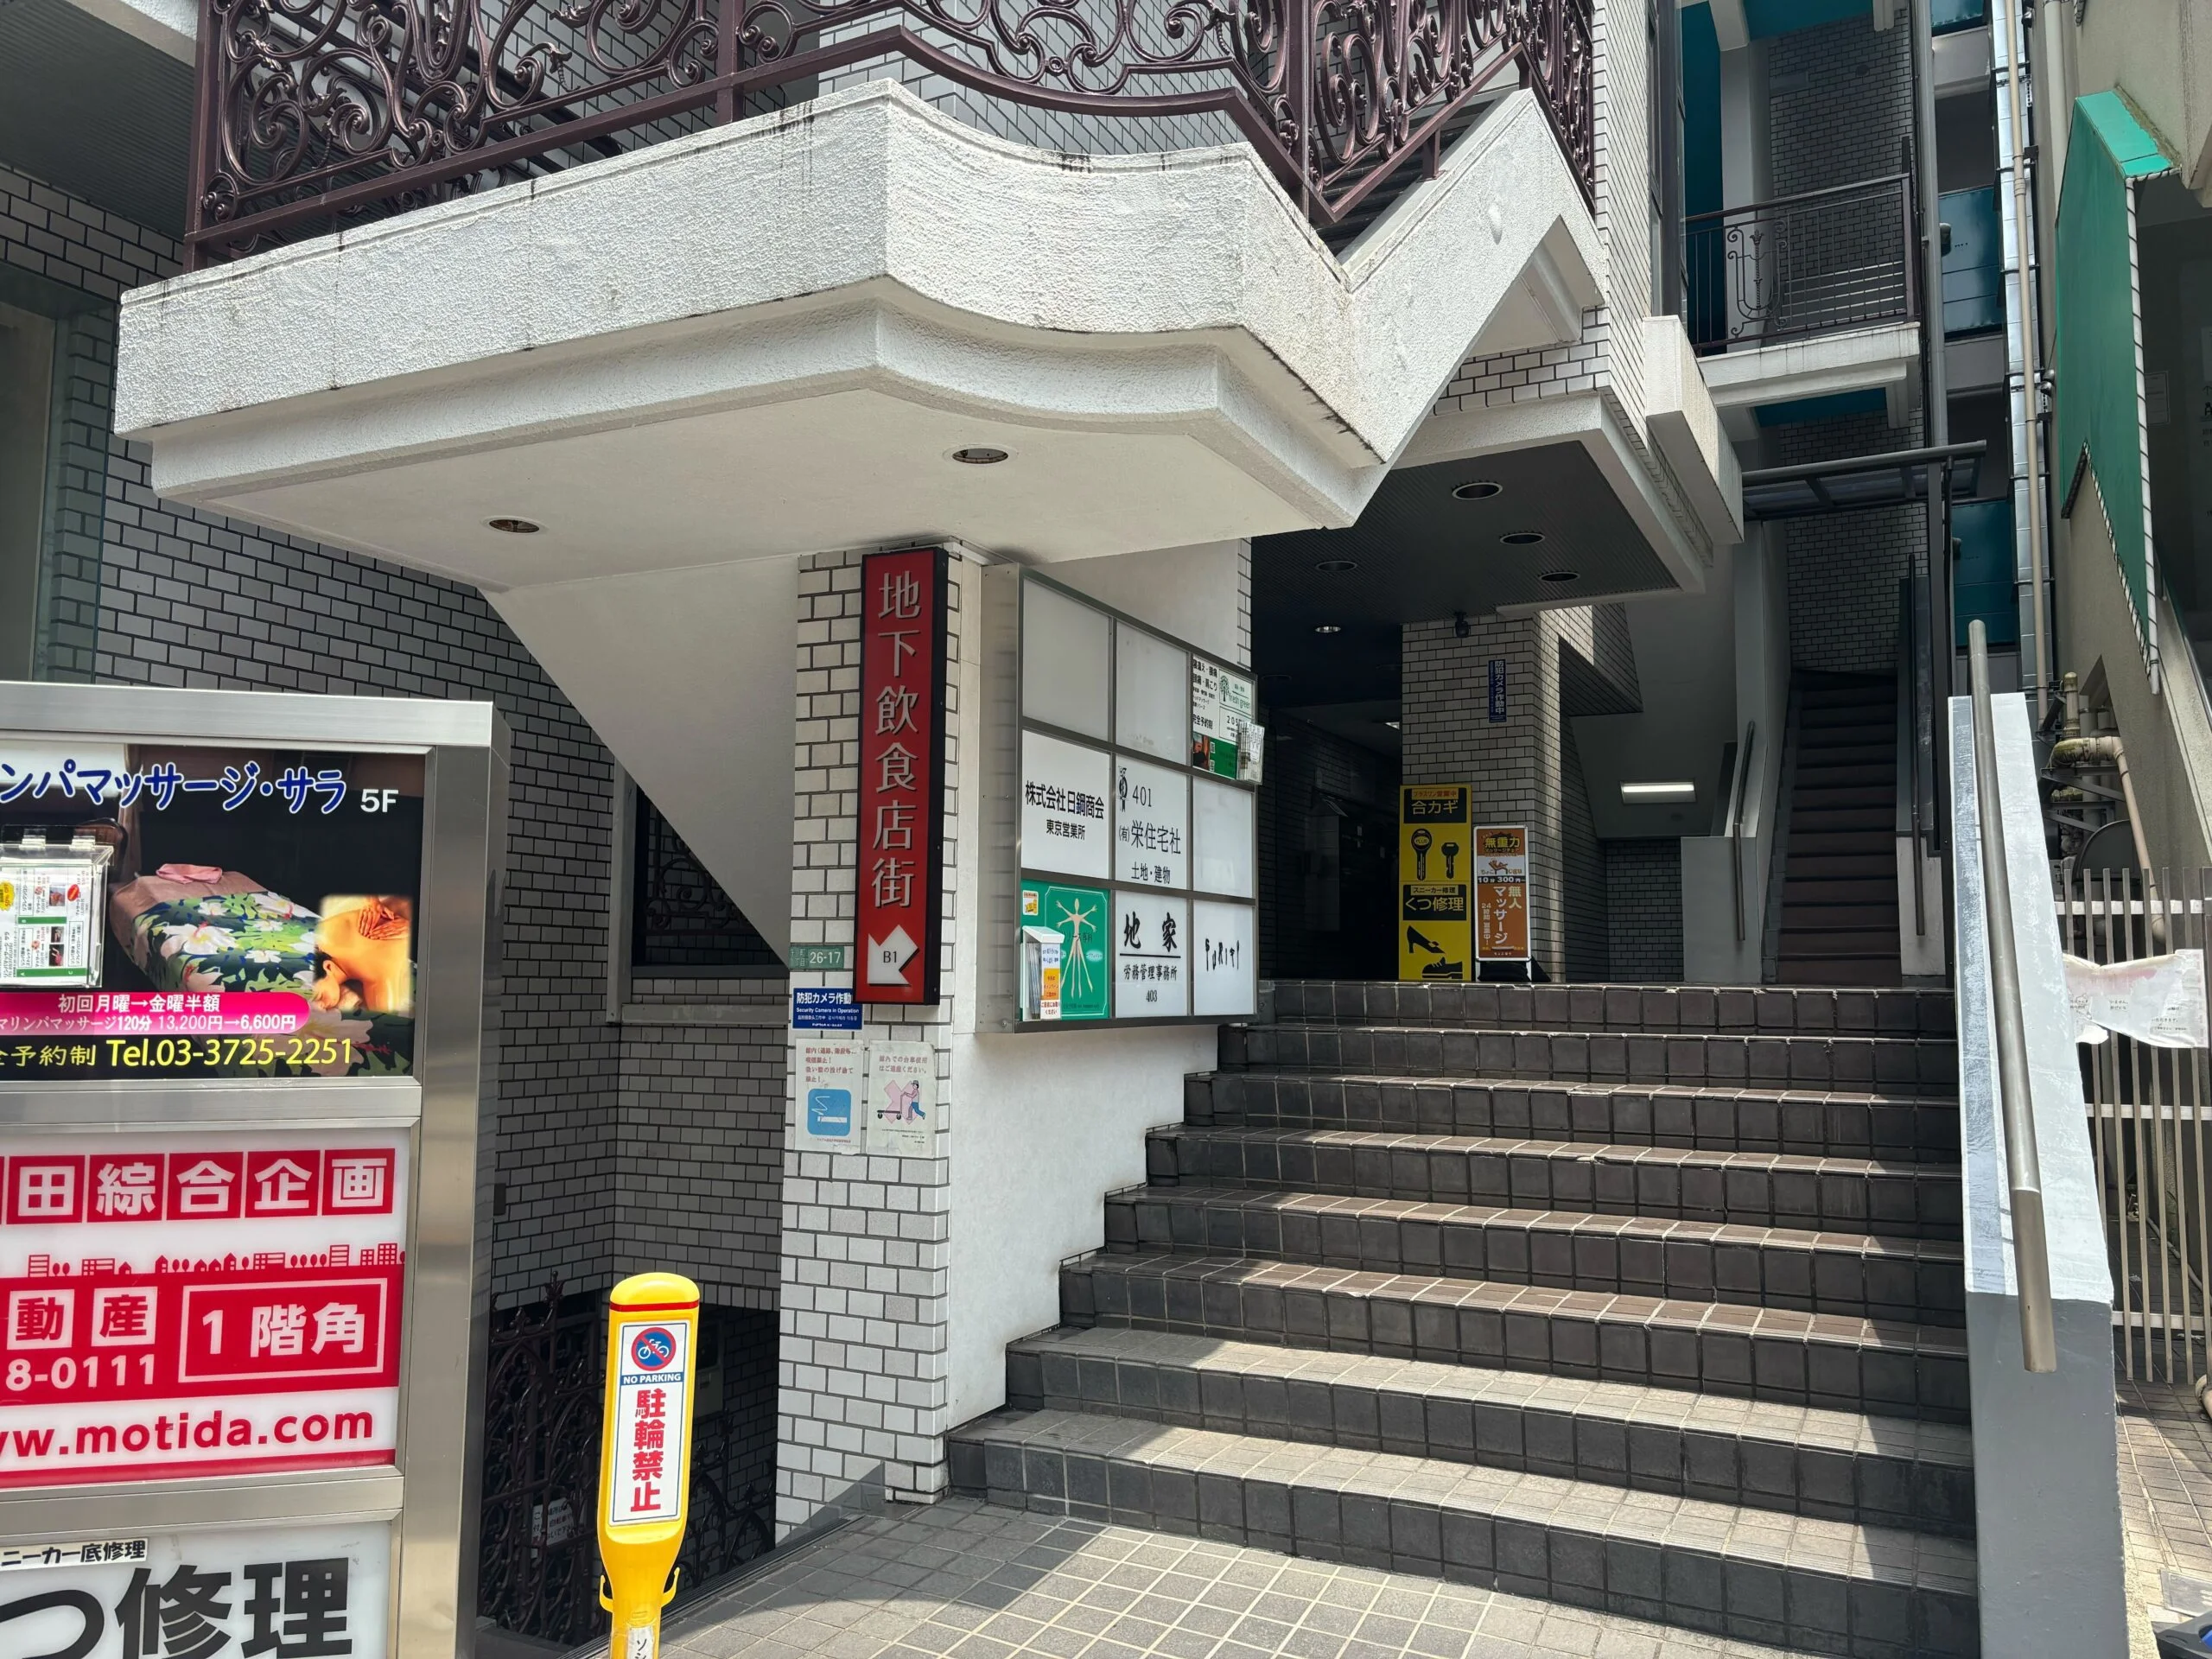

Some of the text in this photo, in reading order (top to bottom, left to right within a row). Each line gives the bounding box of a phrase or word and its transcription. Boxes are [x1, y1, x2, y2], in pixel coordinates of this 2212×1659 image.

[1495, 661, 1505, 714] 防犯カメラ作動中
[871, 571, 922, 908] 地下飲食店街
[360, 789, 399, 813] 5F
[1133, 785, 1152, 807] 401
[1411, 800, 1459, 815] 合カギ
[1046, 819, 1085, 840] 東京営業所
[1484, 836, 1520, 849] 無重力
[1131, 861, 1171, 884] 土地・建物
[1405, 897, 1464, 912] くつ修理
[1508, 886, 1522, 909] 無人
[1493, 886, 1508, 944] マッサージ
[810, 951, 842, 964] 26-17
[883, 950, 898, 963] B1
[1123, 964, 1177, 982] 労務管理事務所
[1146, 990, 1157, 1002] 403
[106, 1039, 351, 1066] Tel.03-3725-2251
[16, 1294, 149, 1341] 動産
[6, 1354, 156, 1391] 8-0111
[623, 1372, 681, 1384] NO PARKING
[0, 1410, 372, 1459] w.motida.com
[630, 1388, 666, 1514] 駐輪禁止
[1, 1540, 146, 1567] ニーカー底修理
